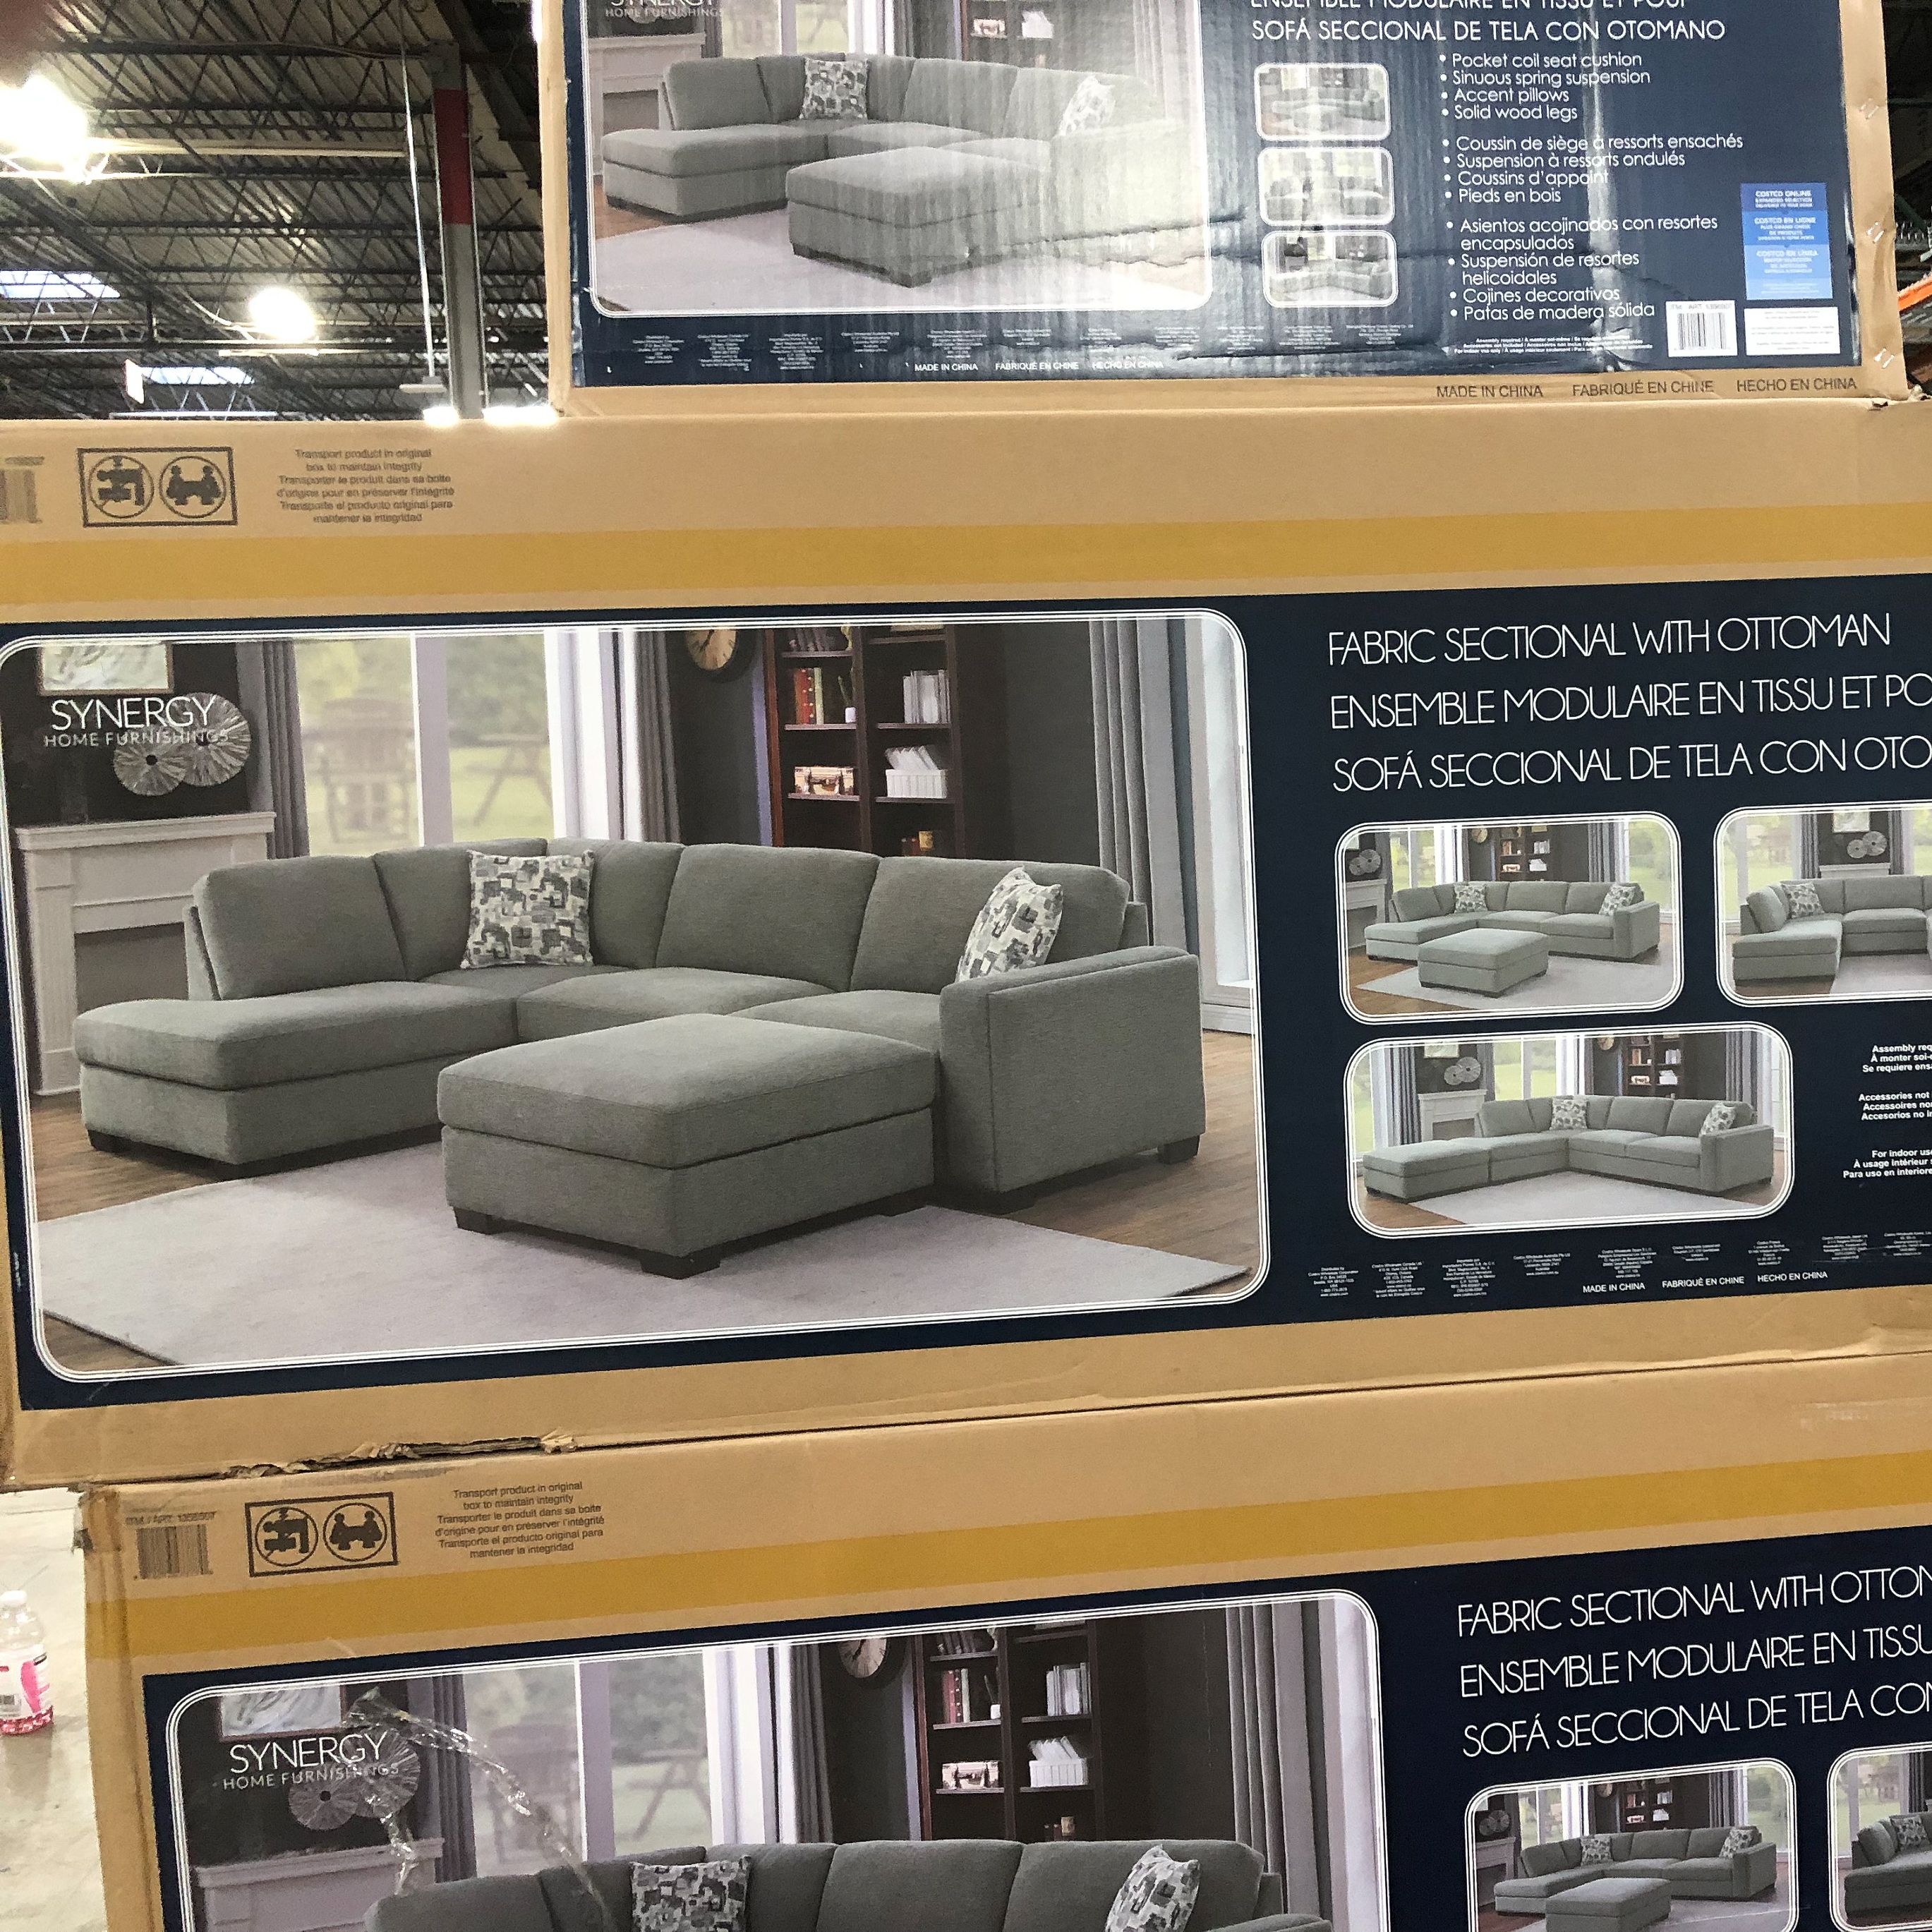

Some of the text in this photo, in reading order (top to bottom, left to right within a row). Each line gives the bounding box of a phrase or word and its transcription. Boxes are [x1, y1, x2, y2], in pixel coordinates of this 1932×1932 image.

[1252, 18, 1726, 41] SOFÁ SECCIONAL DE TELA CON OTOMANO
[1452, 52, 1642, 68] Pocket coil seat cushion
[1452, 69, 1651, 88] Sinuous spring suspension
[1454, 87, 1569, 104] Accent pillows
[1454, 104, 1578, 122] Solid wood legs
[1456, 133, 1744, 153] Coussin de siège à ressorts ensachés
[1456, 151, 1686, 171] Suspension à ressorts ondulés
[1458, 169, 1609, 188] Coussins d'appoint
[1459, 187, 1562, 203] Pieds en bois
[1460, 215, 1718, 236] Asientos acojinados con resortes
[1461, 236, 1574, 253] encapsulados
[1461, 251, 1640, 270] Suspensión de resortes
[1462, 270, 1557, 286] helicoidales
[1463, 286, 1620, 306] Cojines decorativos
[1463, 306, 1509, 321] Patas
[1512, 305, 1535, 320] de
[1538, 304, 1605, 320] madera
[1608, 302, 1655, 318] sólida
[914, 363, 939, 372] MADE
[951, 363, 979, 371] CHINA
[1039, 361, 1079, 370] EN CHINE
[1437, 384, 1543, 398] MADE IN CHINA
[1572, 379, 1715, 396] FABRIQUÉ EN CHINE
[1737, 378, 1857, 392] HECHO EN CHINA
[1329, 612, 1890, 666] FABRIC SECTIONAL WITH OTTOMAN
[1331, 672, 1932, 730] ENSEMBLE MODULAIRE EN TISSU ET PO
[52, 694, 217, 731] SYNERGY
[44, 727, 229, 748] HOME FURNISHINGS
[1332, 735, 1932, 792] SOFÁ SECCIONAL DE TELA CON OTO
[1871, 1044, 1916, 1053] Assembly
[1880, 1054, 1912, 1063] monter
[1862, 1063, 1913, 1073] Se requiere
[1859, 1091, 1930, 1102] Accessories not
[1863, 1101, 1917, 1111] Accessoires
[1861, 1111, 1911, 1121] Accesorios
[1871, 1148, 1917, 1159] For indoor
[1863, 1160, 1890, 1169] usage
[1891, 1157, 1928, 1167] intérieur
[1842, 1170, 1864, 1179] Para
[1865, 1169, 1882, 1178] uso
[1705, 1276, 1717, 1286] EN
[1719, 1275, 1745, 1286] CHINE
[1757, 1270, 1828, 1283] HECHO EN CHINA
[1583, 1281, 1646, 1294] MADE IN CHINA
[453, 1489, 498, 1499] Transport
[500, 1485, 536, 1497] product
[548, 1481, 583, 1493] original
[483, 1501, 492, 1509] to
[495, 1498, 534, 1508] maintain
[536, 1495, 574, 1507] integrity
[437, 1513, 492, 1525] Transporter
[494, 1512, 502, 1521] le
[505, 1509, 537, 1521] produit
[539, 1508, 562, 1517] dans
[439, 1528, 604, 1549] Transporte el producto original para
[478, 1525, 500, 1535] pour
[469, 1548, 514, 1558] mantener
[517, 1546, 526, 1554] la
[1458, 1597, 1562, 1637] FABRIC
[1570, 1581, 1744, 1627] SECTIONAL
[1750, 1574, 1823, 1611] WITH
[1461, 1624, 1932, 1698] ENSEMBLE MODULAIRE EN TISSU
[1463, 1682, 1932, 1757] SOFÁ SECCIONAL DE TELA CO
[229, 1731, 388, 1774] SYNERGY
[223, 1774, 274, 1791] HOME
